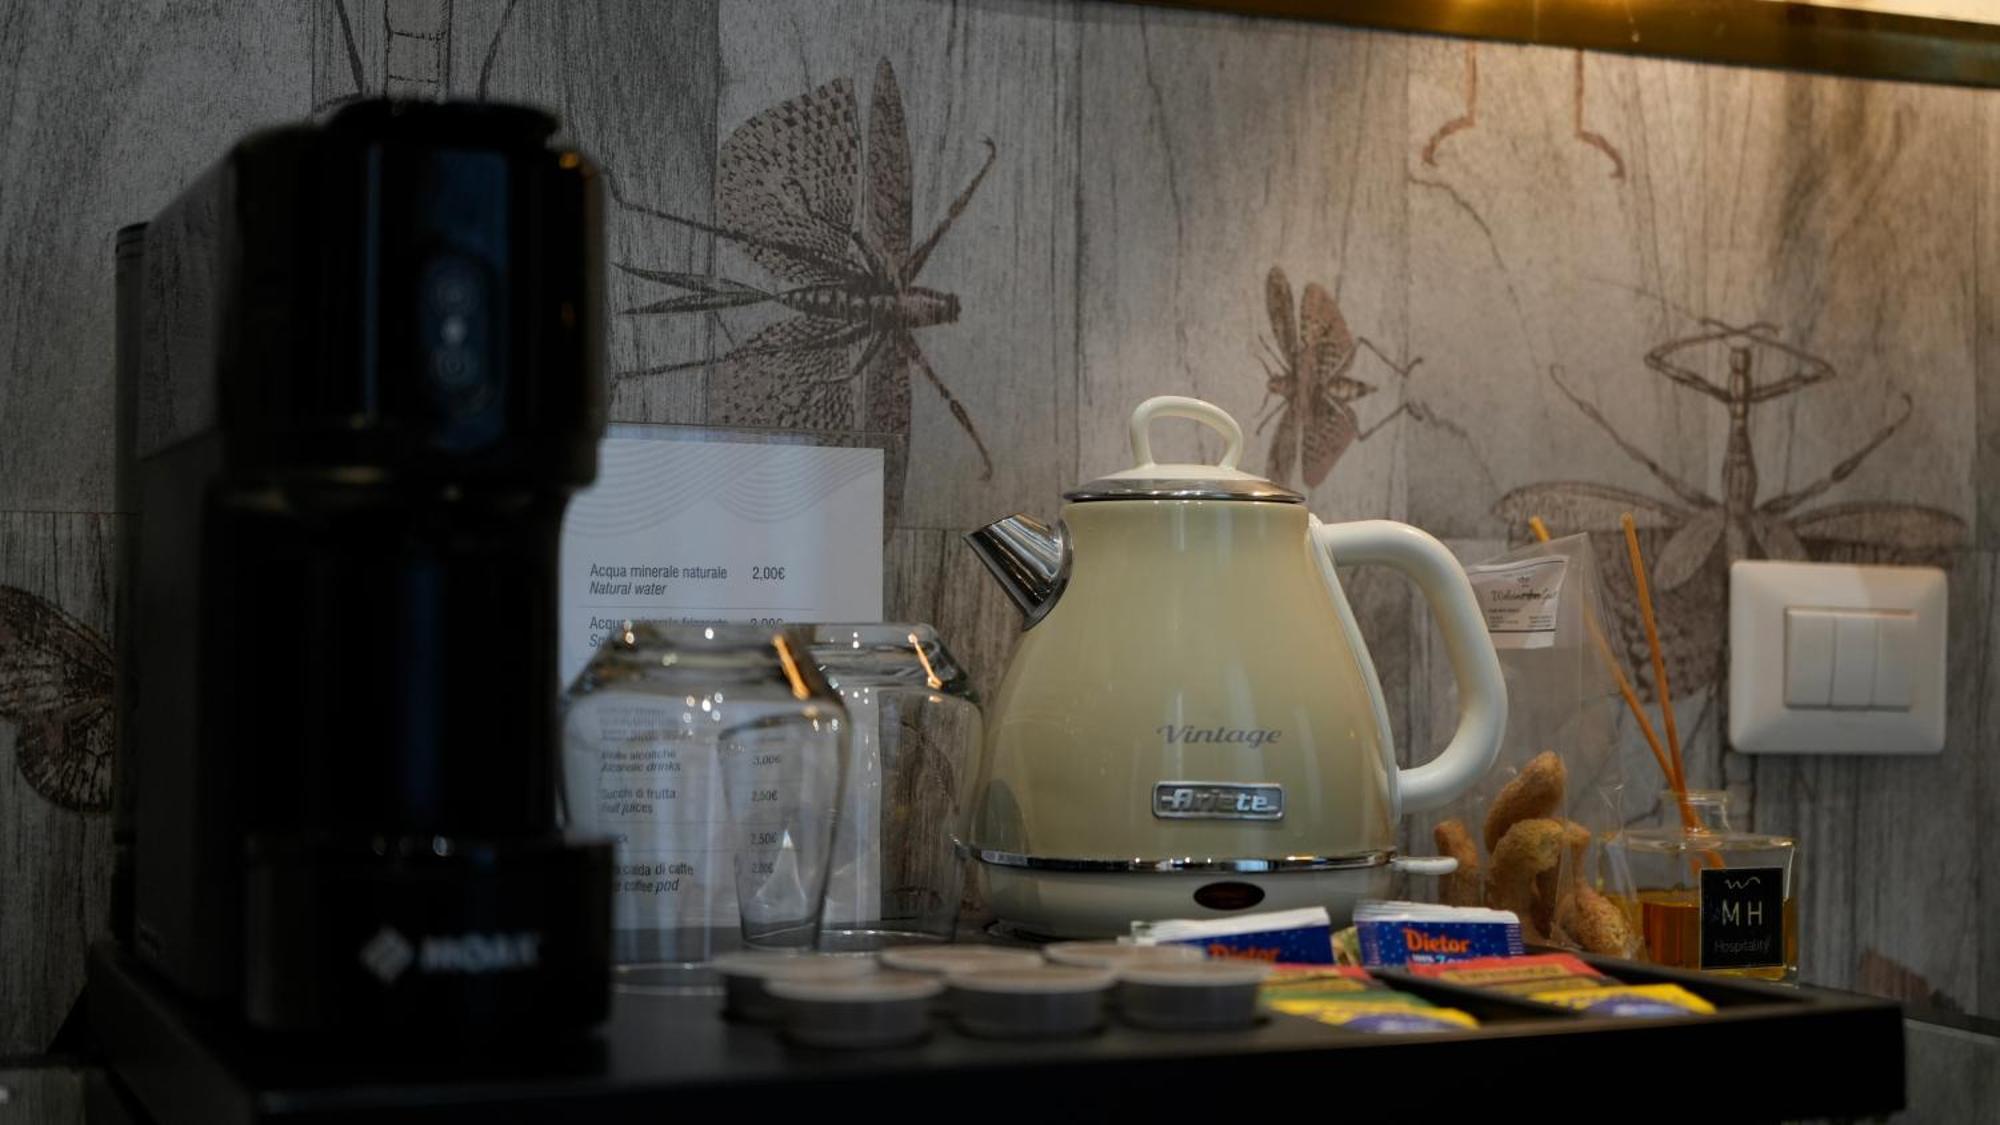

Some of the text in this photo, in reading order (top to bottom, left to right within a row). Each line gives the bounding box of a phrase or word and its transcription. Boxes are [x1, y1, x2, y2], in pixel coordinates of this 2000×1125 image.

[590, 564, 785, 581] Acqua minerale naturale 2,00€
[589, 581, 668, 596] Natural water
[1156, 725, 1282, 748] Vintage
[647, 787, 677, 800] frutta
[655, 862, 667, 876] di
[655, 877, 680, 896] pod
[1403, 927, 1472, 954] Dietor
[1714, 936, 1773, 956] Hospitality
